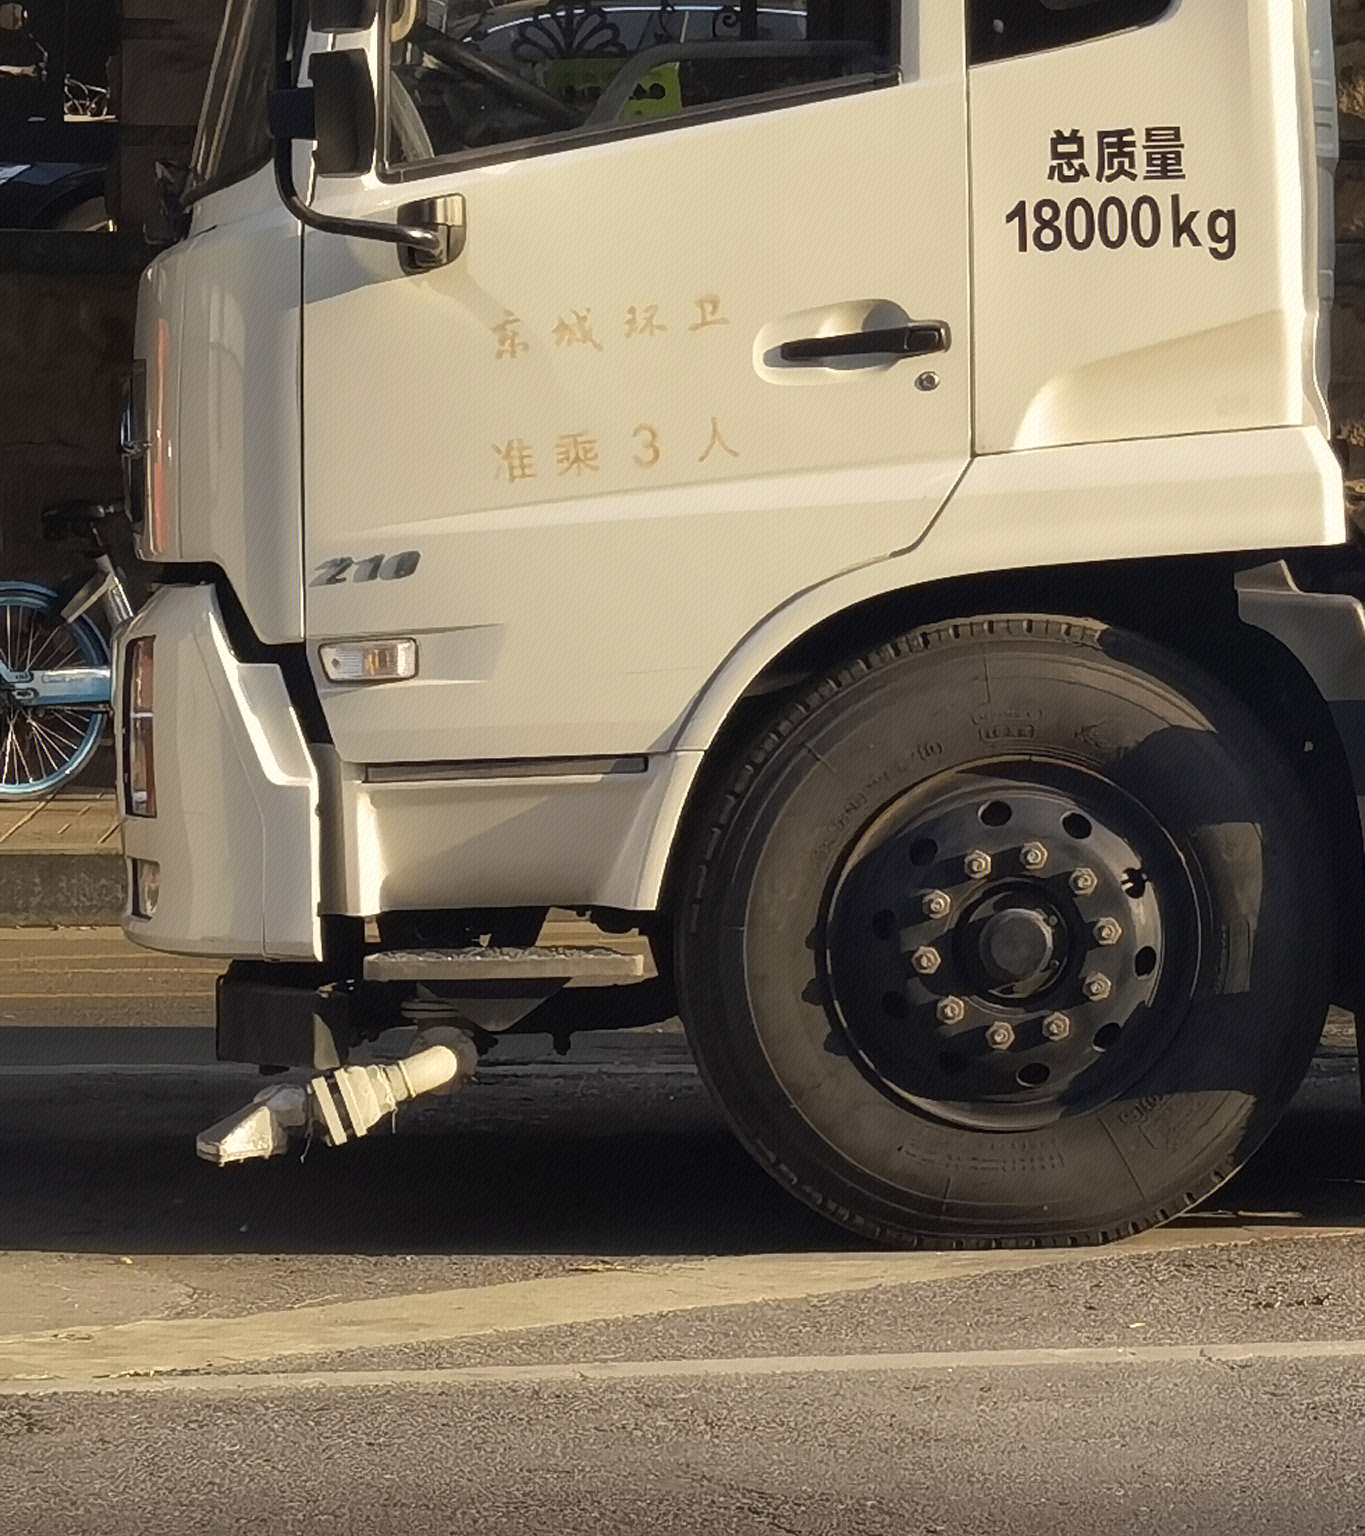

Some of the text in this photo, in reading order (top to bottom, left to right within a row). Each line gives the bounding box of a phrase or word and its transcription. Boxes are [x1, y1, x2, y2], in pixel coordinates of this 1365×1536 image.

[1048, 125, 1187, 184] 总质量
[490, 293, 731, 360] 东城环卫
[490, 415, 741, 485] 准乘3人
[308, 550, 422, 587] 210
